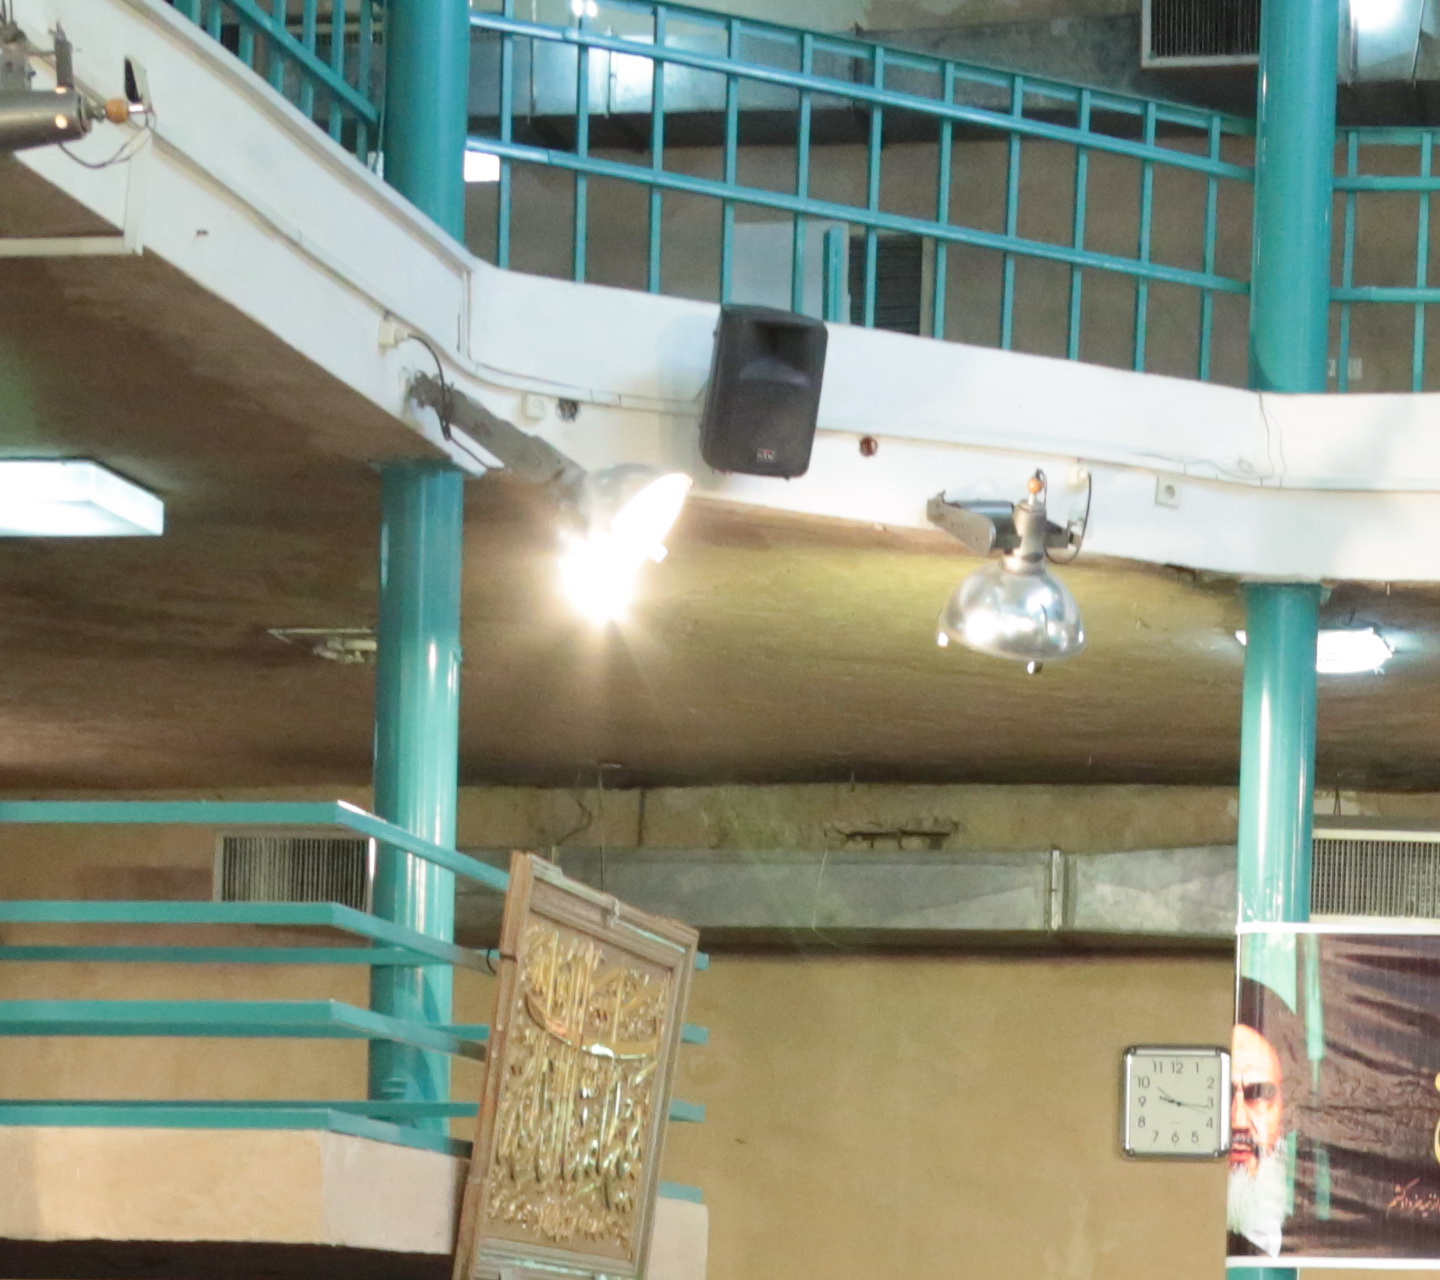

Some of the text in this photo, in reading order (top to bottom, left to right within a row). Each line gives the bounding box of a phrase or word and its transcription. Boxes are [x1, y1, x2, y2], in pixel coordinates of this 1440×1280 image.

[1153, 1061, 1163, 1074] 11
[1171, 1061, 1183, 1074] 12
[1195, 1061, 1200, 1074] 1
[1137, 1076, 1150, 1089] 10
[1207, 1077, 1215, 1089] 2
[1138, 1096, 1147, 1108] 9
[1138, 1116, 1146, 1128] 8
[1206, 1117, 1214, 1129] 4
[1152, 1130, 1159, 1143] 7
[1171, 1131, 1180, 1144] 6
[1191, 1131, 1199, 1144] 5
